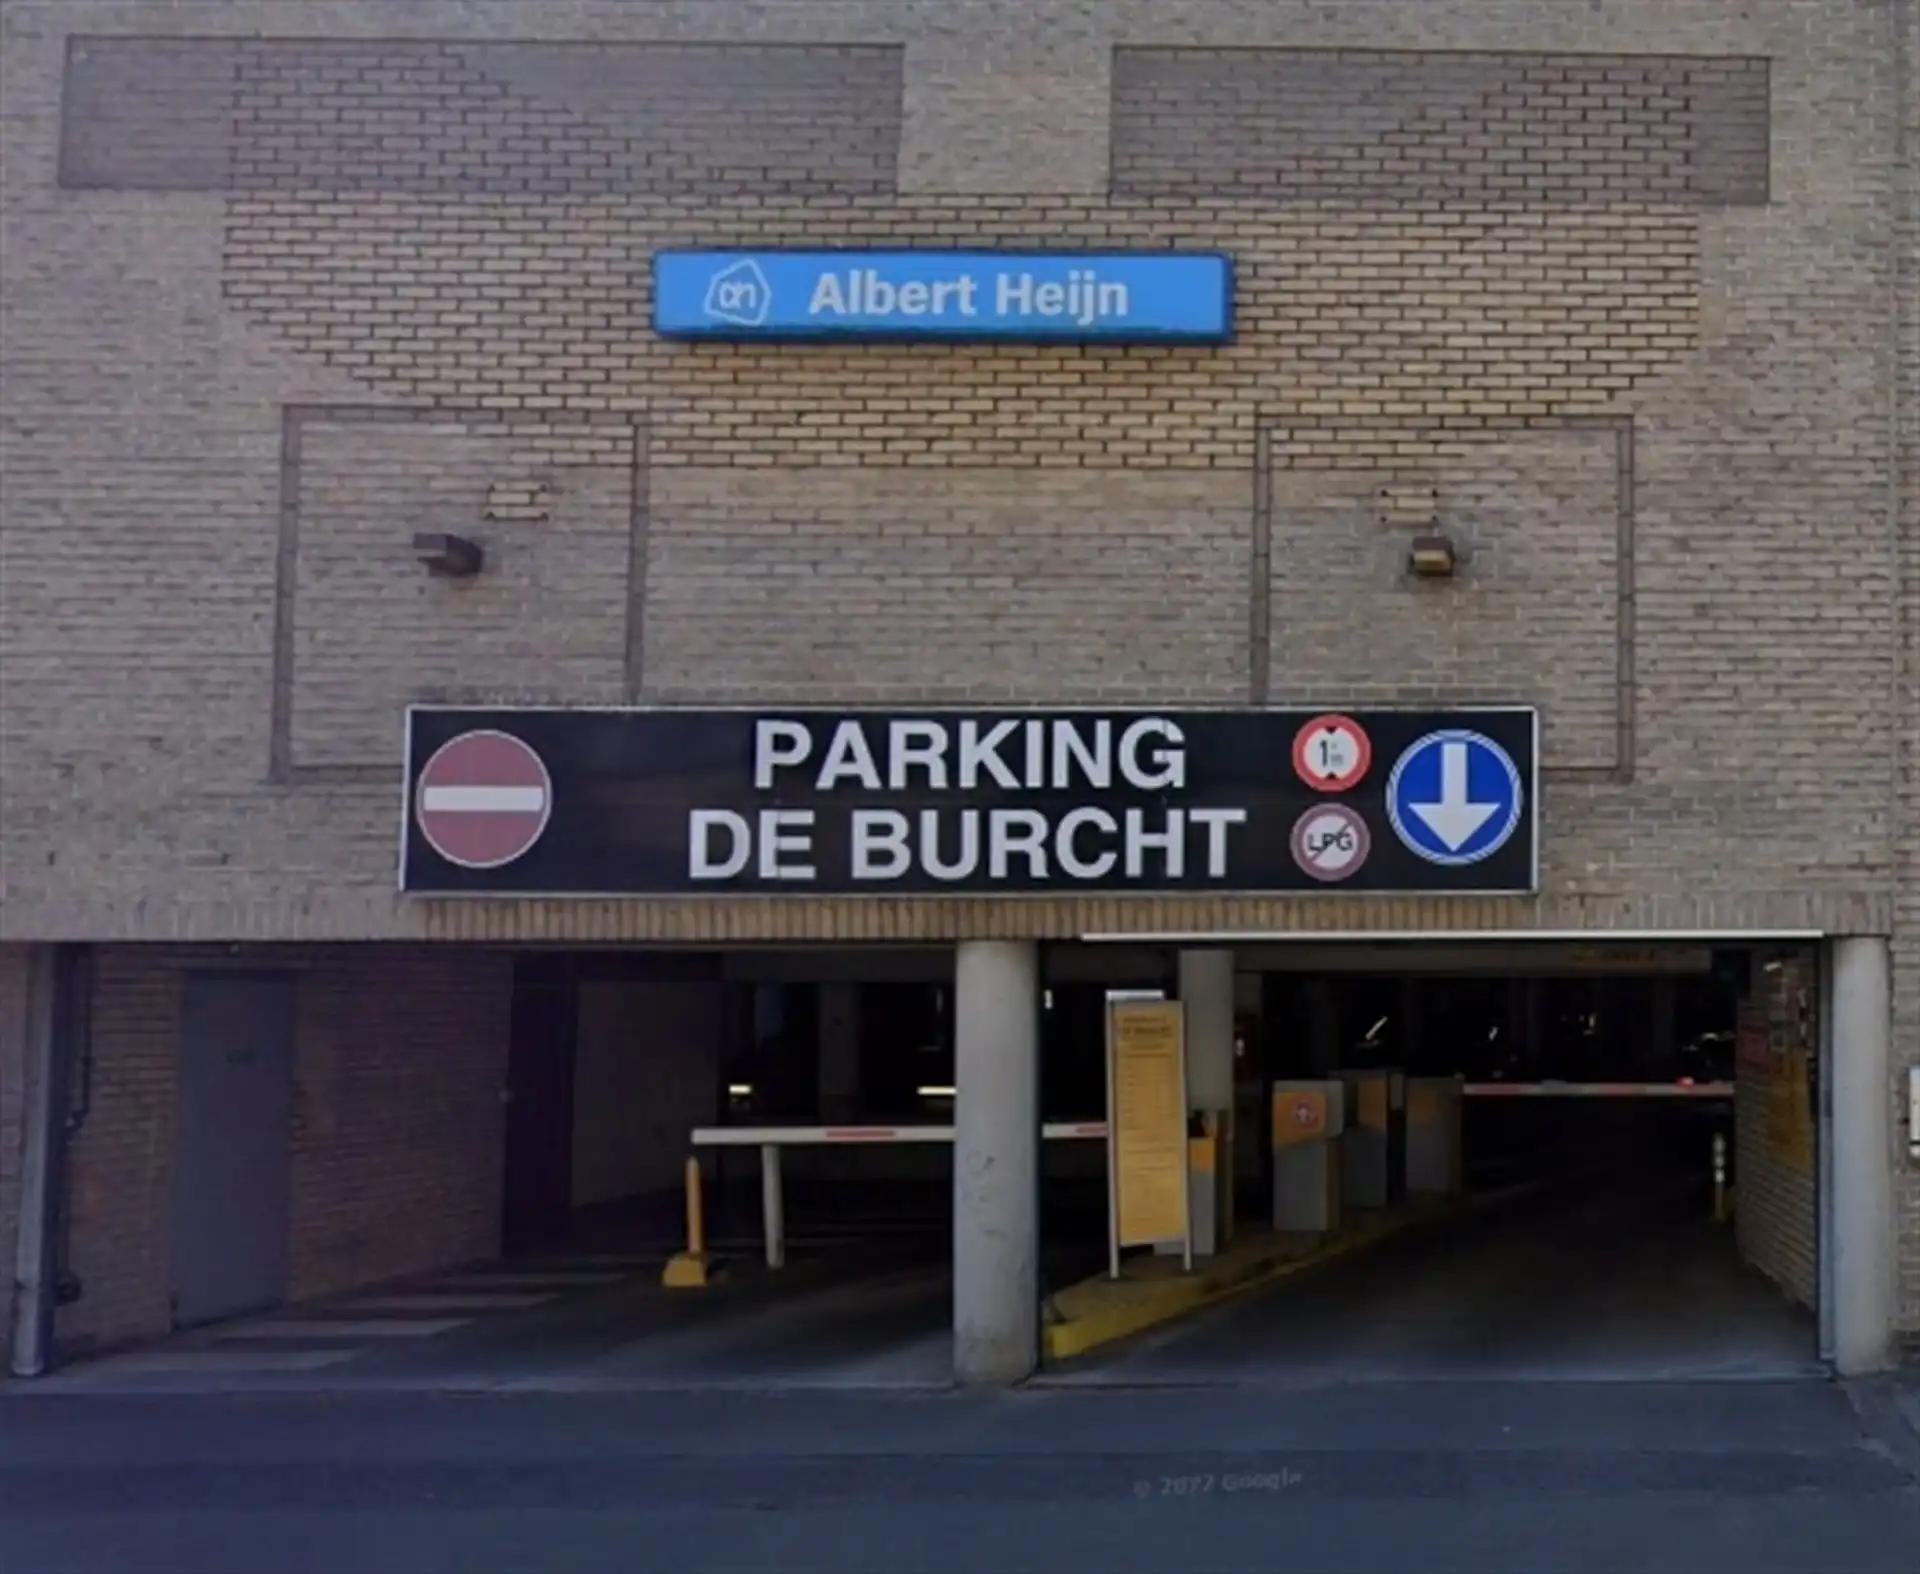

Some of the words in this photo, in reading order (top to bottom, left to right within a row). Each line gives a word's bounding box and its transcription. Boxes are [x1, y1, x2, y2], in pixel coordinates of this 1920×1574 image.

[809, 269, 977, 316] Albert
[996, 270, 1128, 326] Heijn
[755, 717, 1185, 790] PARKING
[689, 809, 816, 880] DE
[851, 806, 1247, 880] BURCHT
[1307, 832, 1353, 852] LPG
